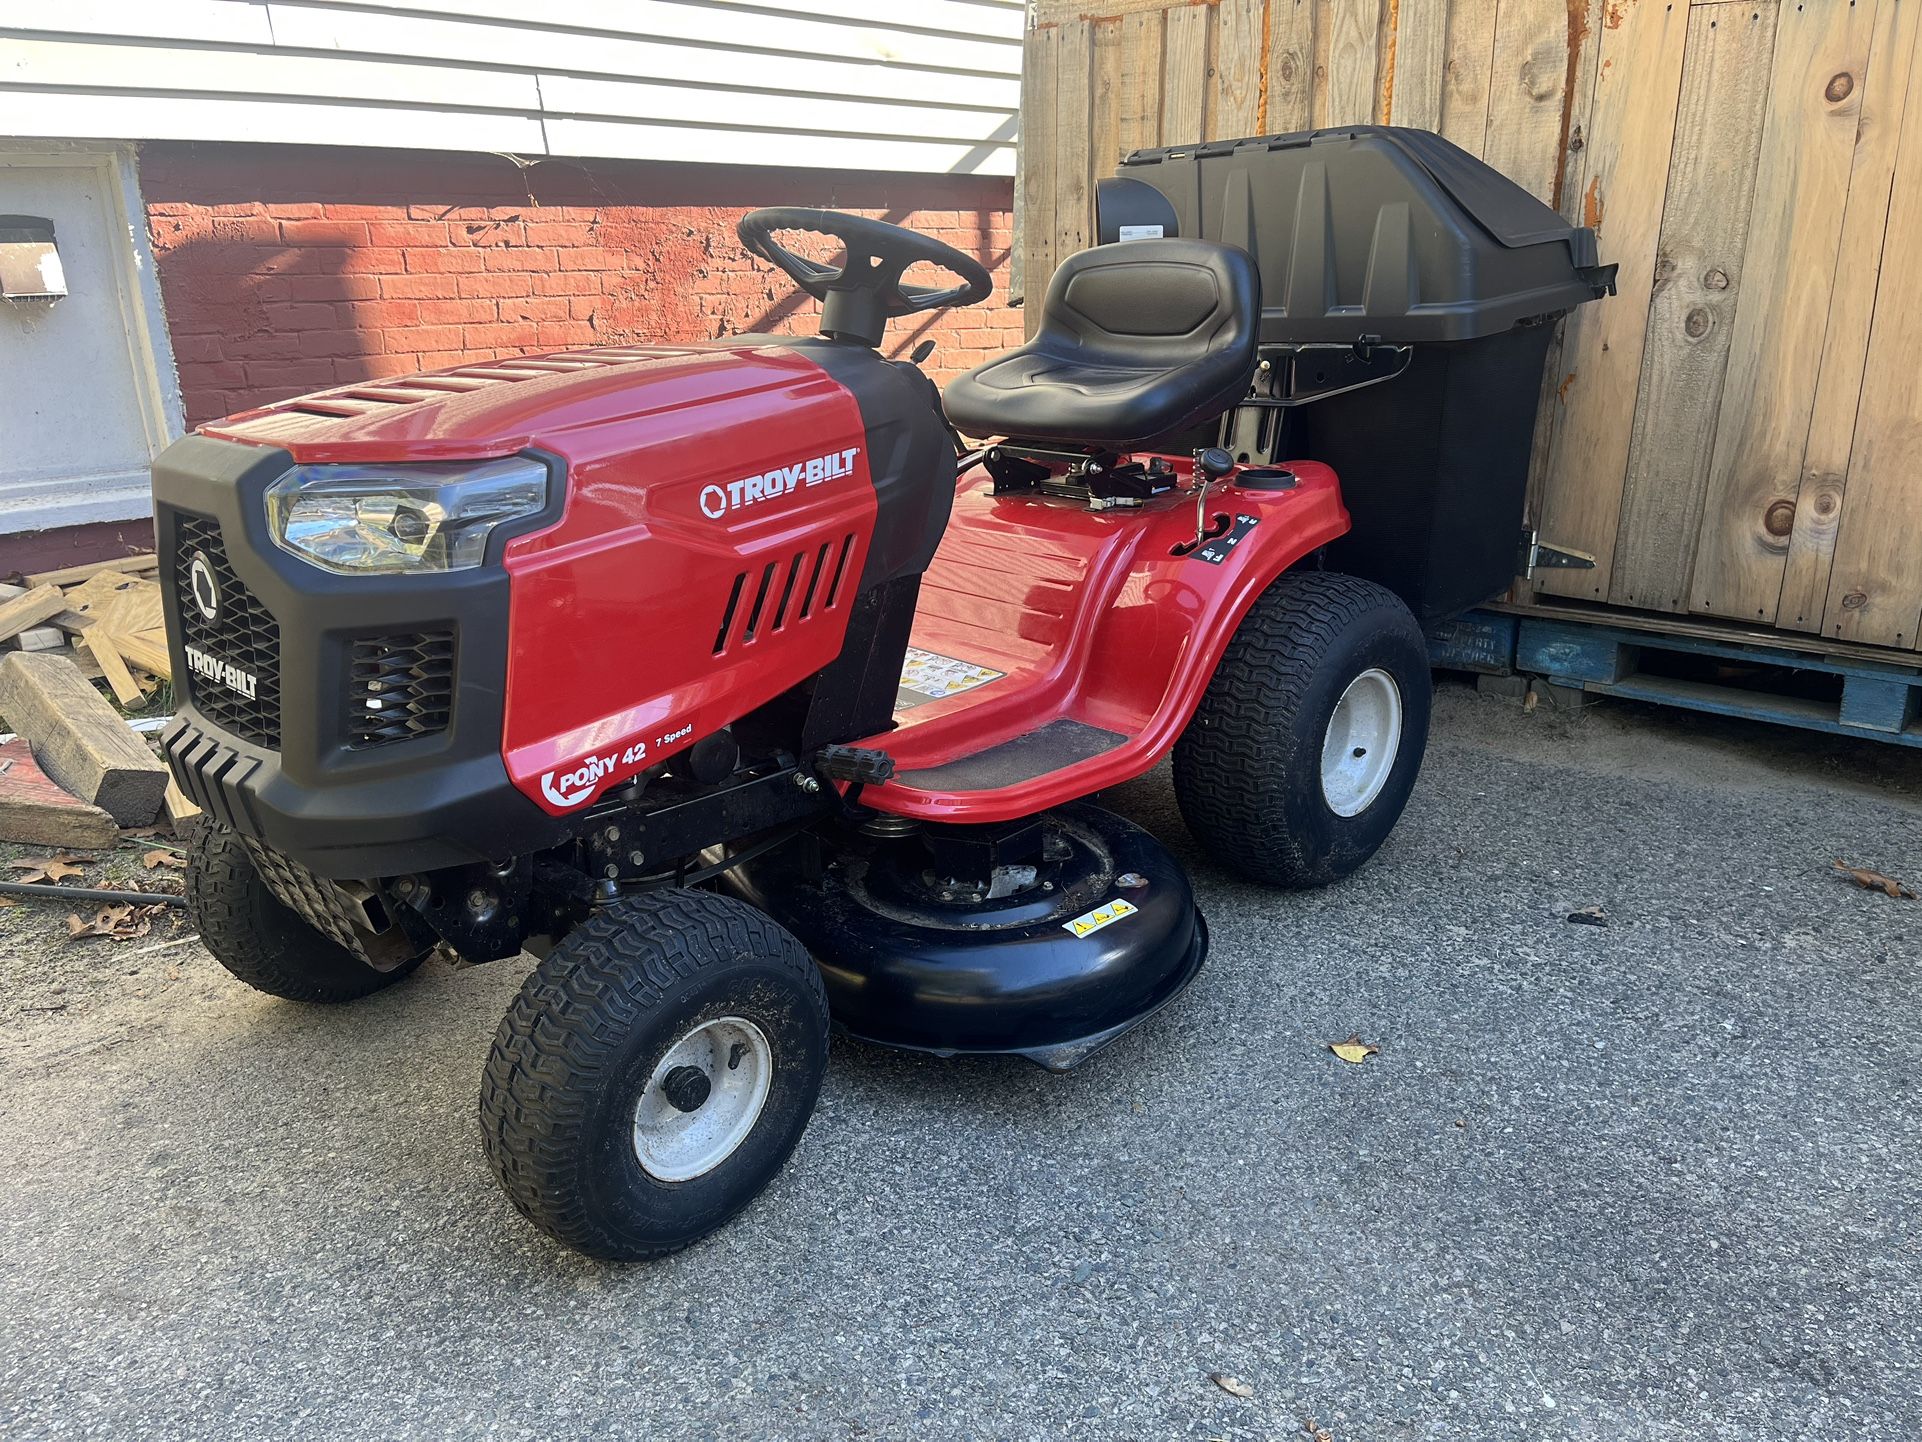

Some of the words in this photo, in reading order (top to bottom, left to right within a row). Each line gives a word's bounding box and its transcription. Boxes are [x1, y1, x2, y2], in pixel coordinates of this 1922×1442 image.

[727, 447, 858, 510] TROY-BILT
[1213, 554, 1225, 562] F
[1227, 537, 1237, 545] N
[184, 645, 257, 701] TROY-BILT
[560, 753, 619, 793] PONY
[621, 742, 646, 765] 42
[655, 738, 662, 748] 7
[663, 723, 692, 745] Speed
